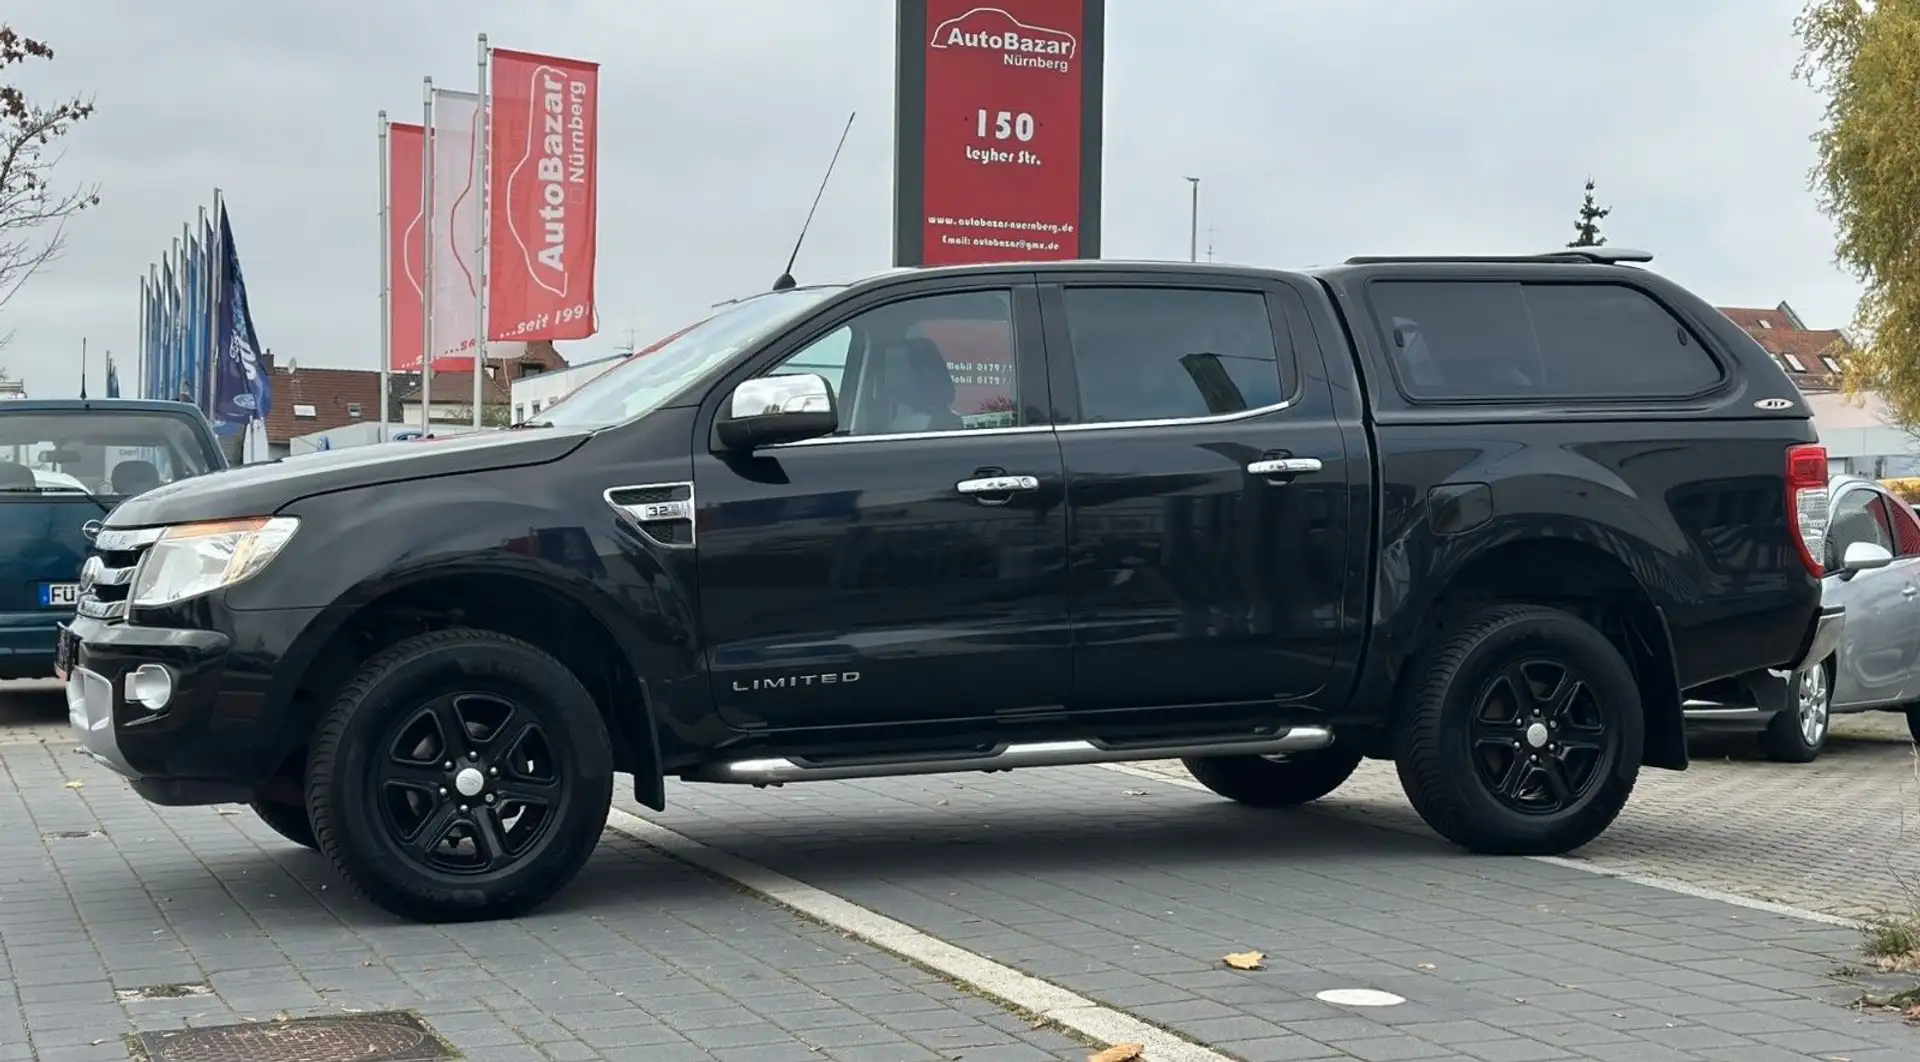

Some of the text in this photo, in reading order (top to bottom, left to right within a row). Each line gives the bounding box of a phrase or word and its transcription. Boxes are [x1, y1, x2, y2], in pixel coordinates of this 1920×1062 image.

[948, 28, 1070, 54] AutoBazar
[1003, 54, 1068, 73] Nürnberg
[568, 80, 586, 184] Nürnberg
[977, 109, 1034, 141] 150
[966, 146, 1041, 165] Leyher Str.
[538, 73, 565, 272] AutoBazar
[928, 216, 1074, 234] www.autobazar-nuernberg.de
[942, 235, 1060, 251] Email: autobazar@gmx.de
[733, 672, 860, 692] LIMITED
